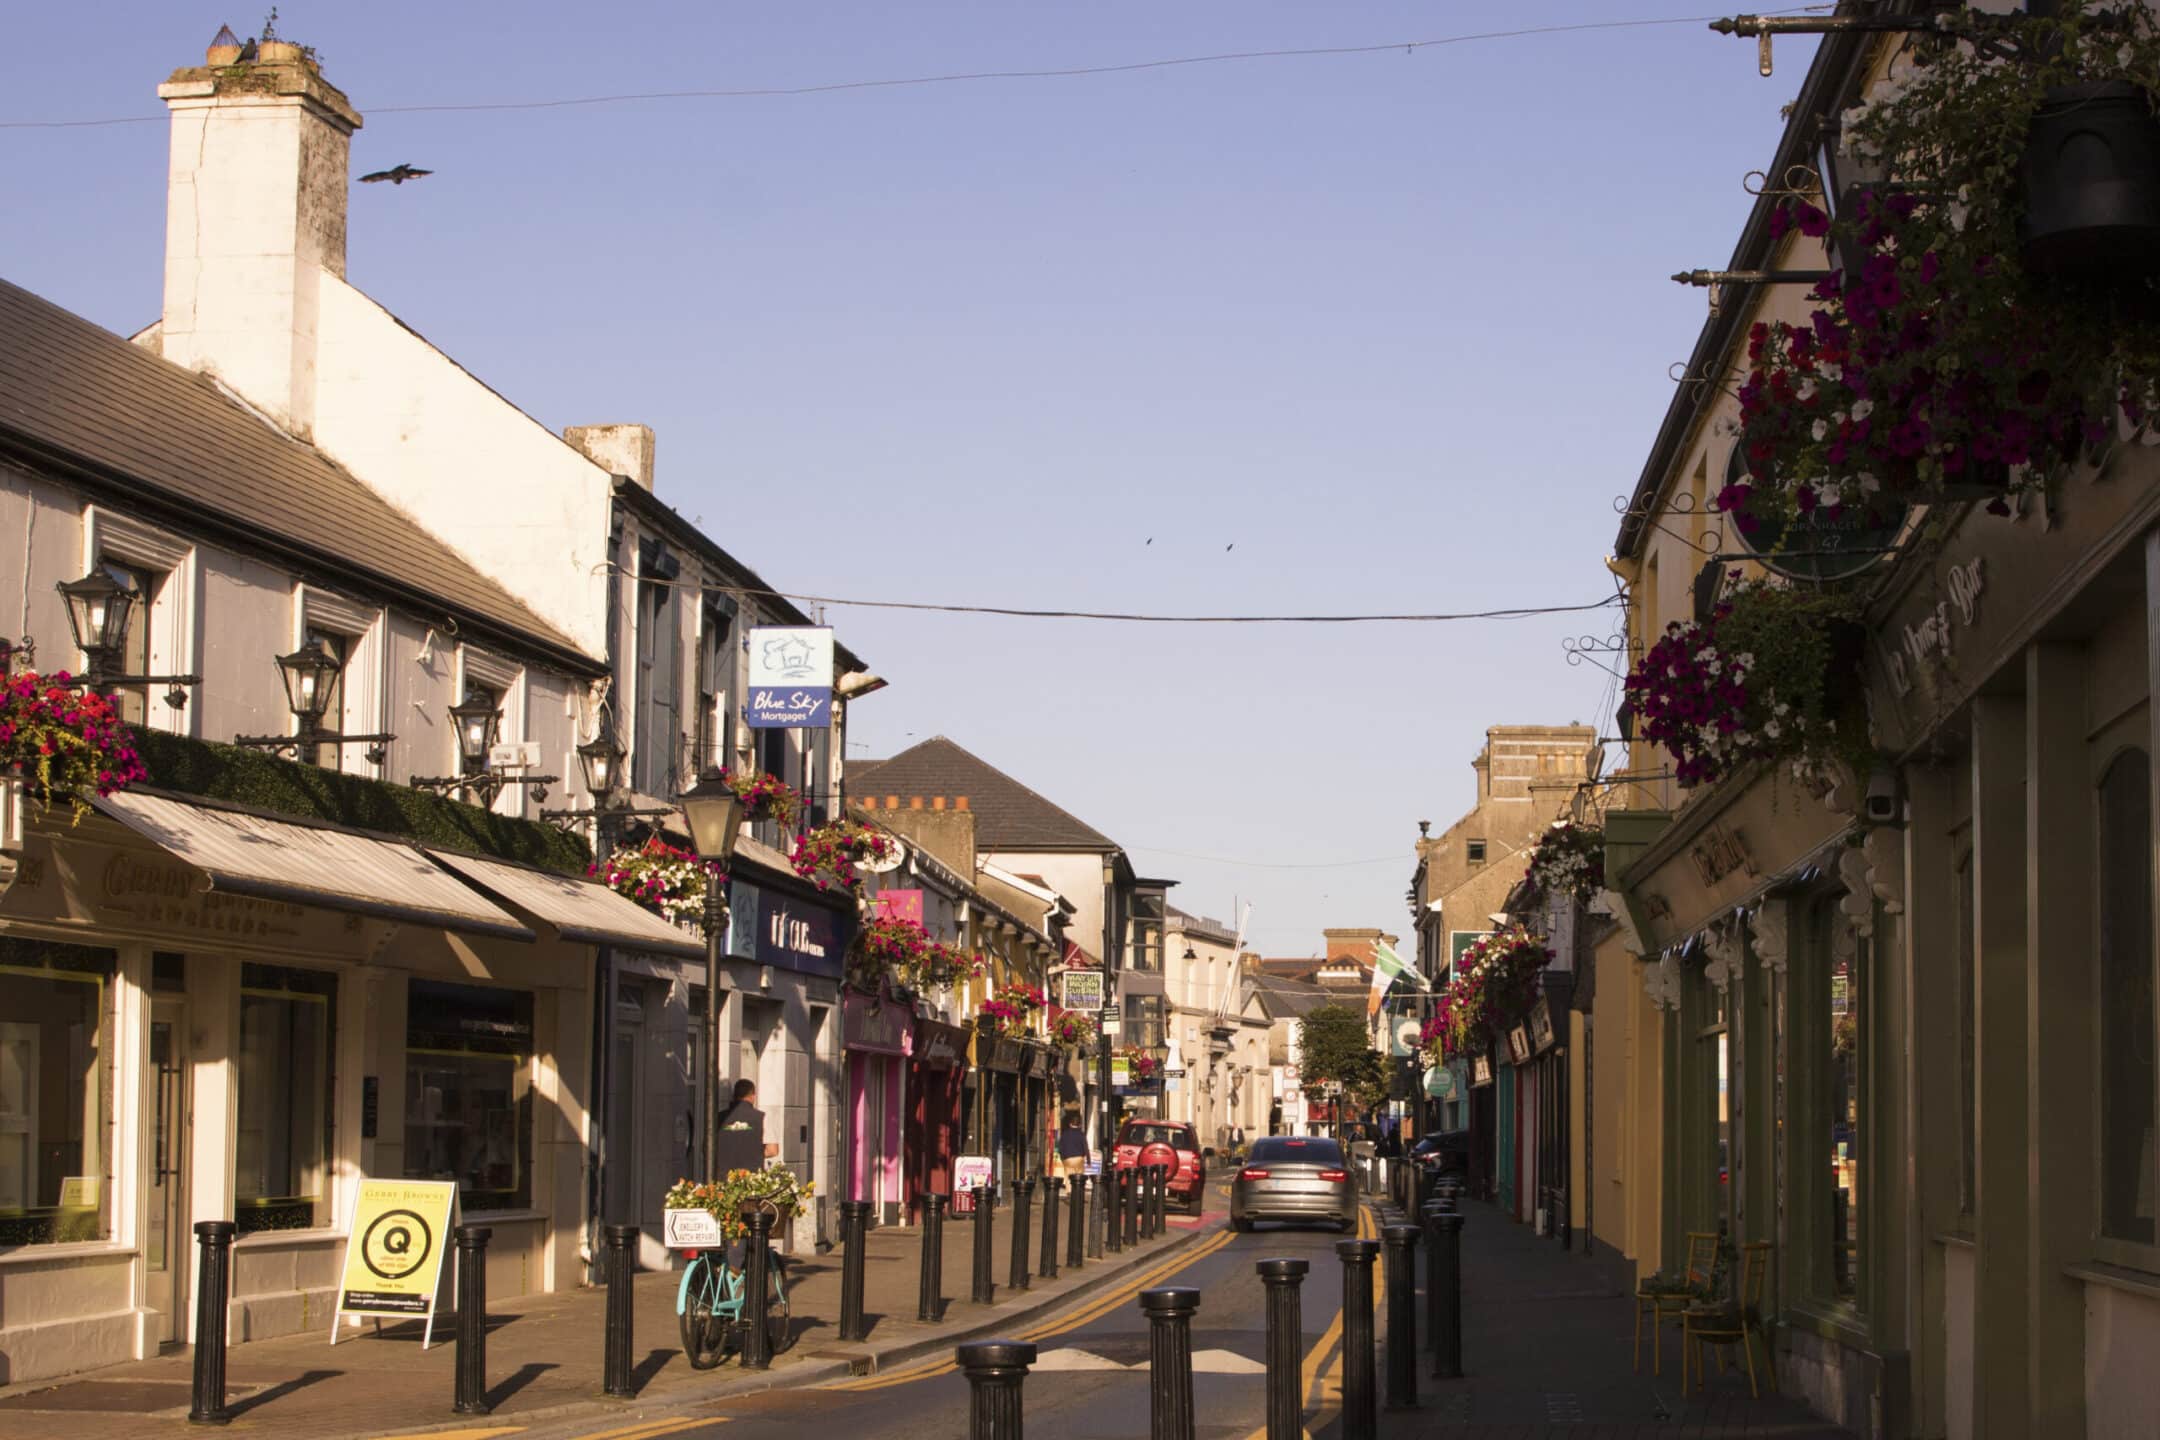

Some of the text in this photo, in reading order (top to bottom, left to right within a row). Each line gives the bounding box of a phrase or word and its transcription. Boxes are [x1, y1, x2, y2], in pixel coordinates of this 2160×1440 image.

[754, 690, 823, 716] Blue Sky
[761, 712, 807, 722] Mortgages
[383, 1226, 411, 1254] Q
